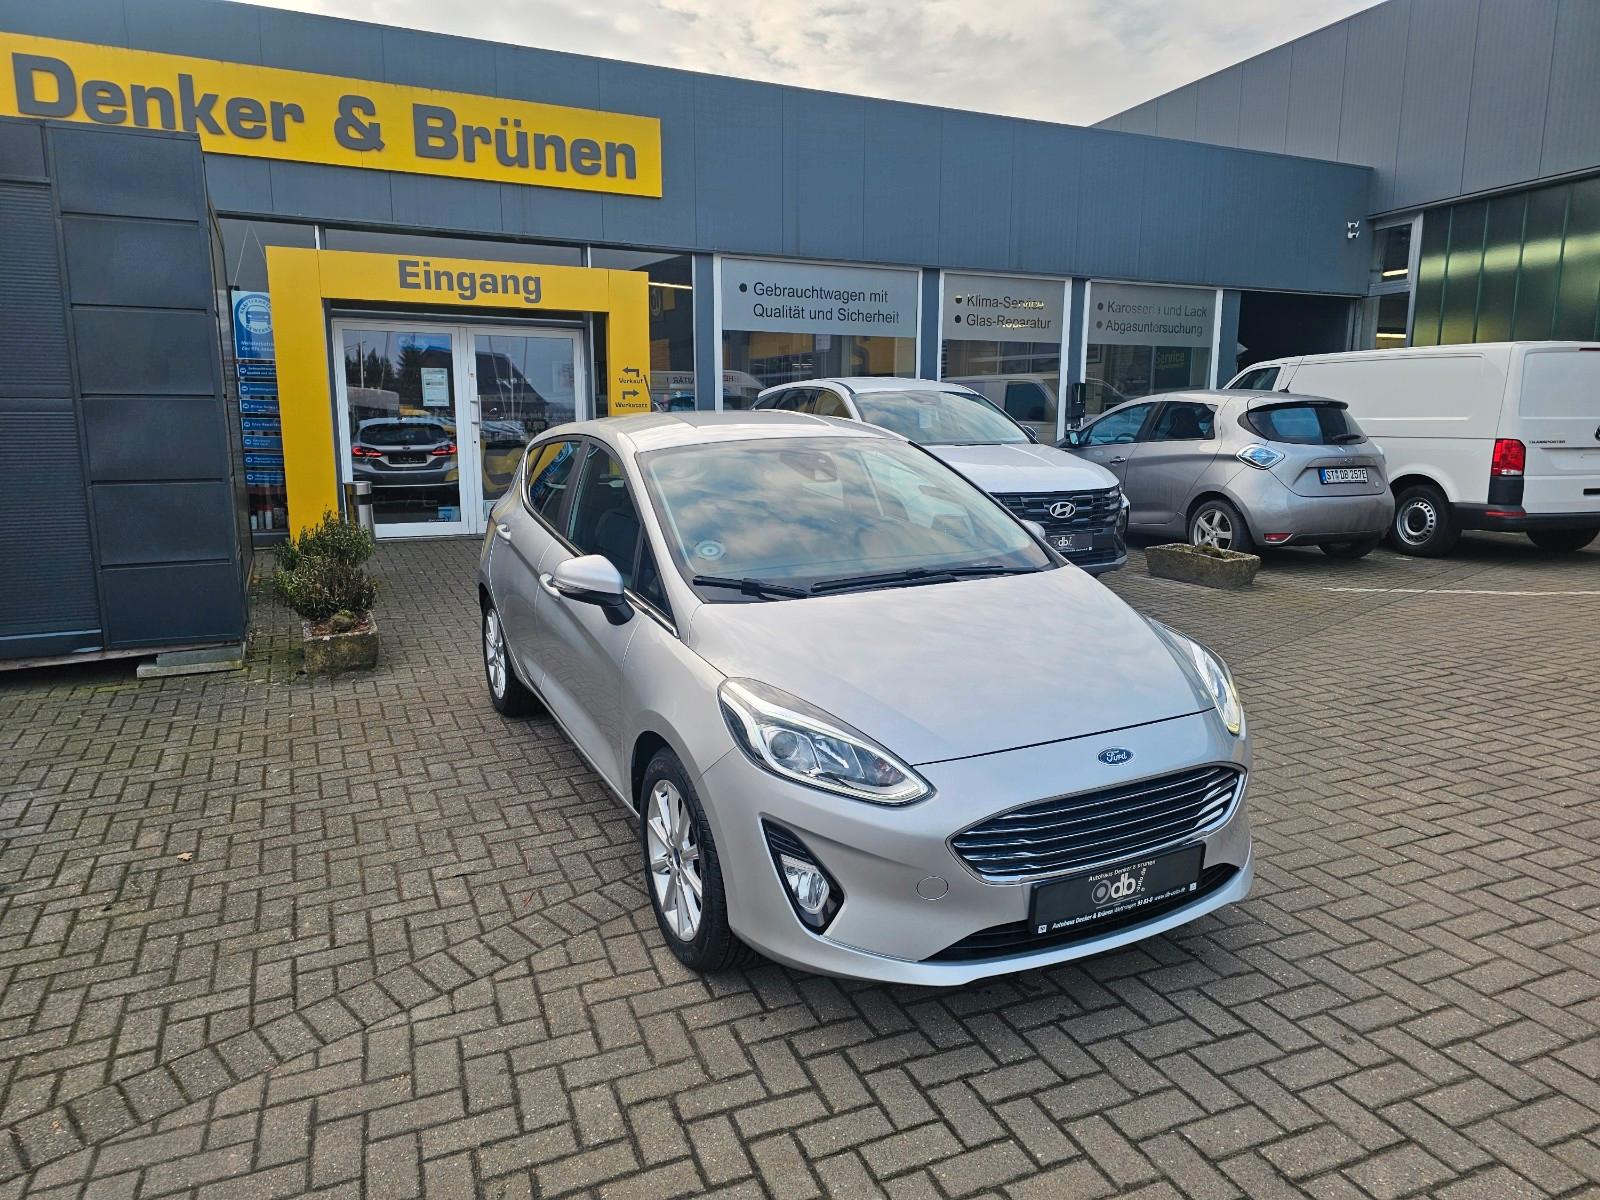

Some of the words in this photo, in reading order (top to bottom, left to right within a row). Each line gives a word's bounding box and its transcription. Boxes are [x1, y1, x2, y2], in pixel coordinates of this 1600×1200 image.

[11, 51, 305, 142] Denker
[333, 94, 386, 153] &
[412, 102, 637, 180] Brünen
[398, 259, 542, 304] Eingang
[753, 282, 866, 304] Gebrauchtwagen
[869, 289, 889, 303] mit
[967, 294, 1044, 310] Klima-Service
[753, 303, 805, 320] Qualität
[809, 307, 833, 321] und
[837, 308, 900, 324] Sicherheit
[1163, 305, 1181, 317] und
[1184, 305, 1208, 318] Lack
[966, 313, 1052, 331] Glas-Reparatur
[1105, 319, 1203, 337] Abgasuntersuchung
[1326, 470, 1335, 480] ST
[1088, 871, 1114, 882] Autohaus
[1110, 872, 1136, 899] db
